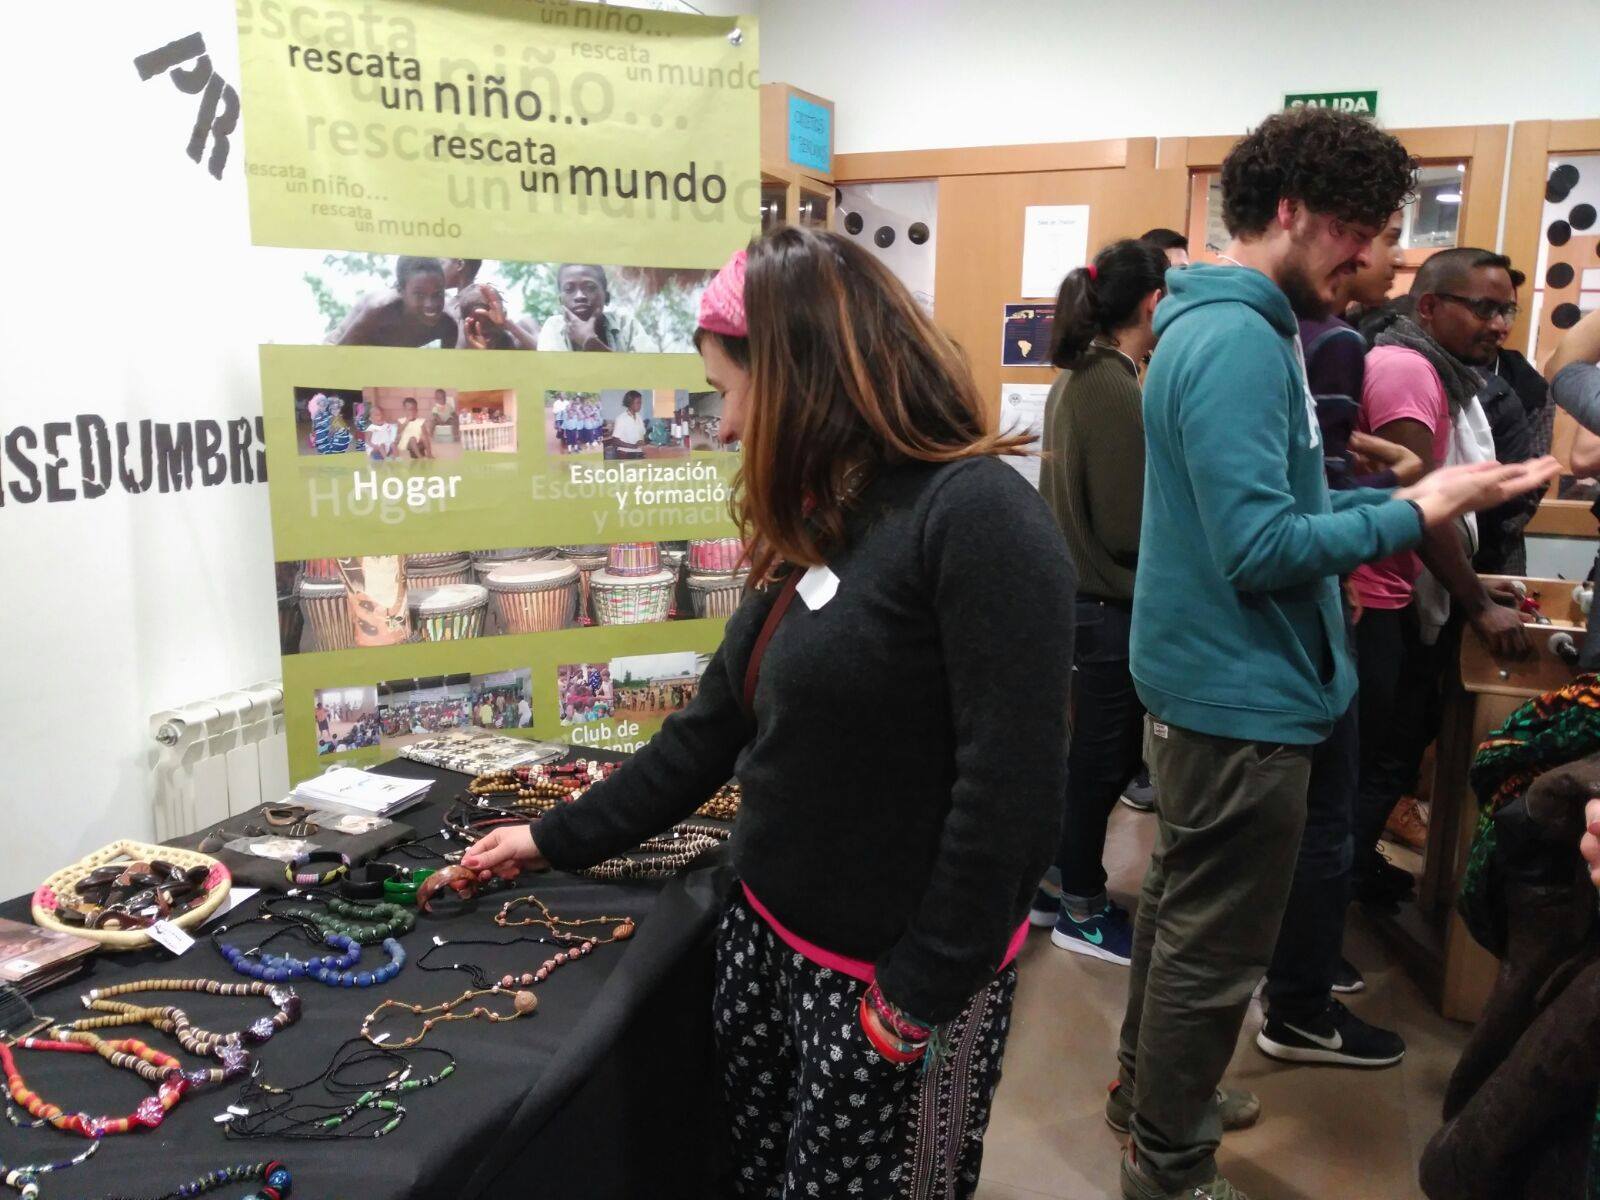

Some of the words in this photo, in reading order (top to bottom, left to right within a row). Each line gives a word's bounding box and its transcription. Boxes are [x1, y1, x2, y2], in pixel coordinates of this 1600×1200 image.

[288, 44, 421, 82] rescata
[571, 39, 650, 64] rescata
[626, 65, 652, 83] un
[381, 85, 424, 112] un
[434, 73, 589, 127] niño...
[432, 133, 556, 166] rescata
[285, 180, 308, 194] un
[312, 174, 389, 202] niño...
[521, 169, 559, 194] un
[569, 161, 727, 204] mundo
[311, 202, 373, 220] rescata
[354, 218, 375, 233] un
[378, 217, 462, 239] mundo
[570, 461, 718, 485] Escolarización
[353, 470, 462, 507] Hogar
[615, 490, 629, 510] y
[592, 509, 608, 536] y
[571, 722, 612, 744] Club
[617, 719, 640, 738] de
